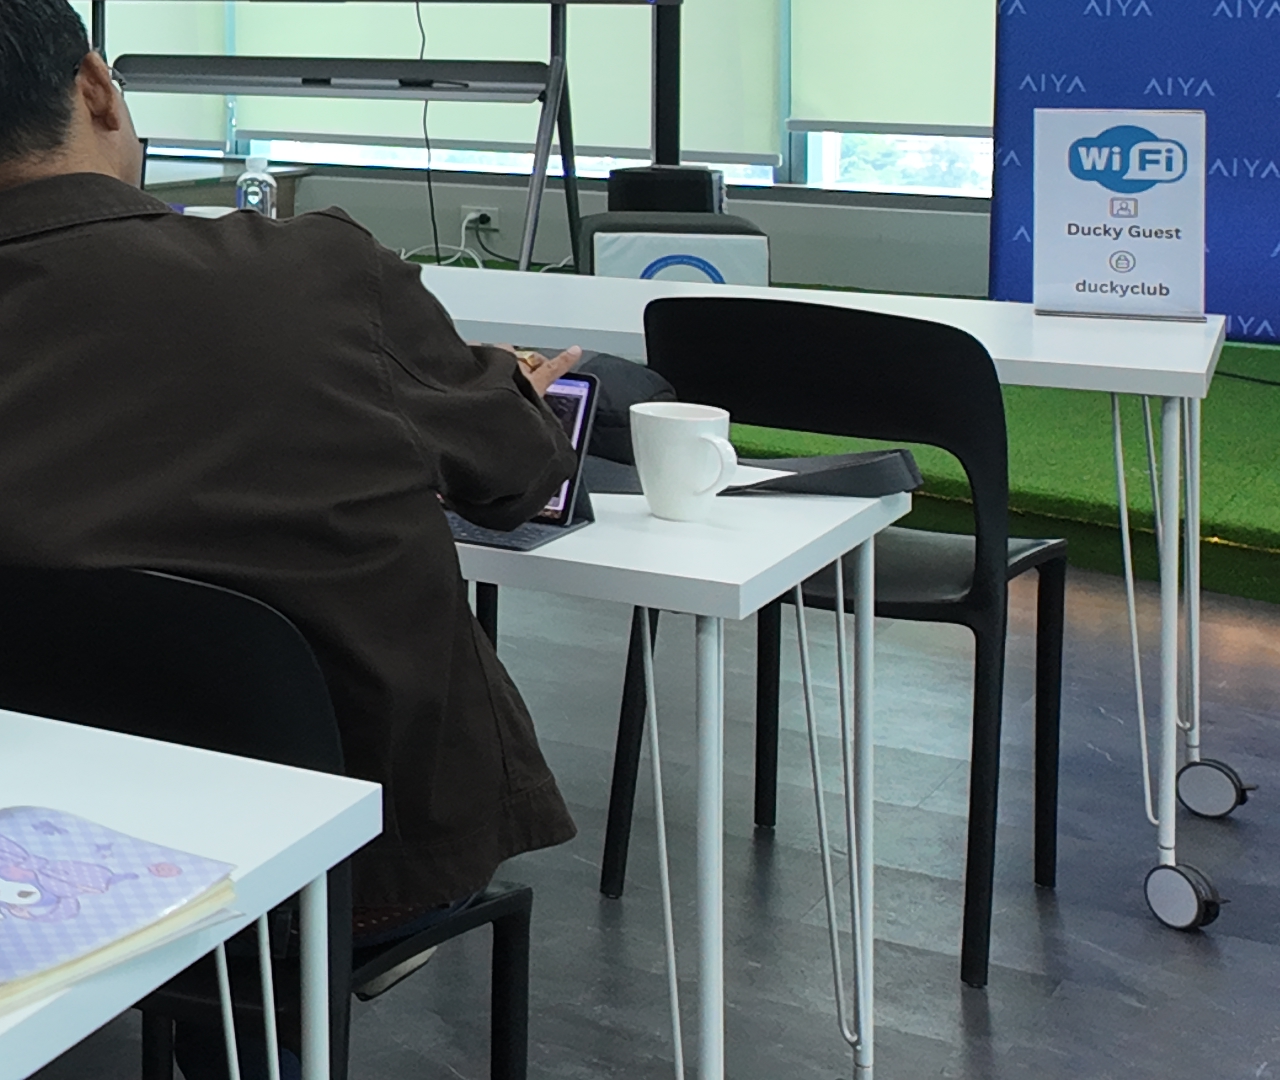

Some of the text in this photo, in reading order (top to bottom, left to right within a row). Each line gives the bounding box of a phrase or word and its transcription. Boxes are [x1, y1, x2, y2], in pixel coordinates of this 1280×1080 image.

[1019, 74, 1215, 97] AIYA AIYA
[1067, 223, 1182, 240] Ducky Guest
[1075, 280, 1170, 297] duckyclub
[1226, 315, 1275, 337] IYA
